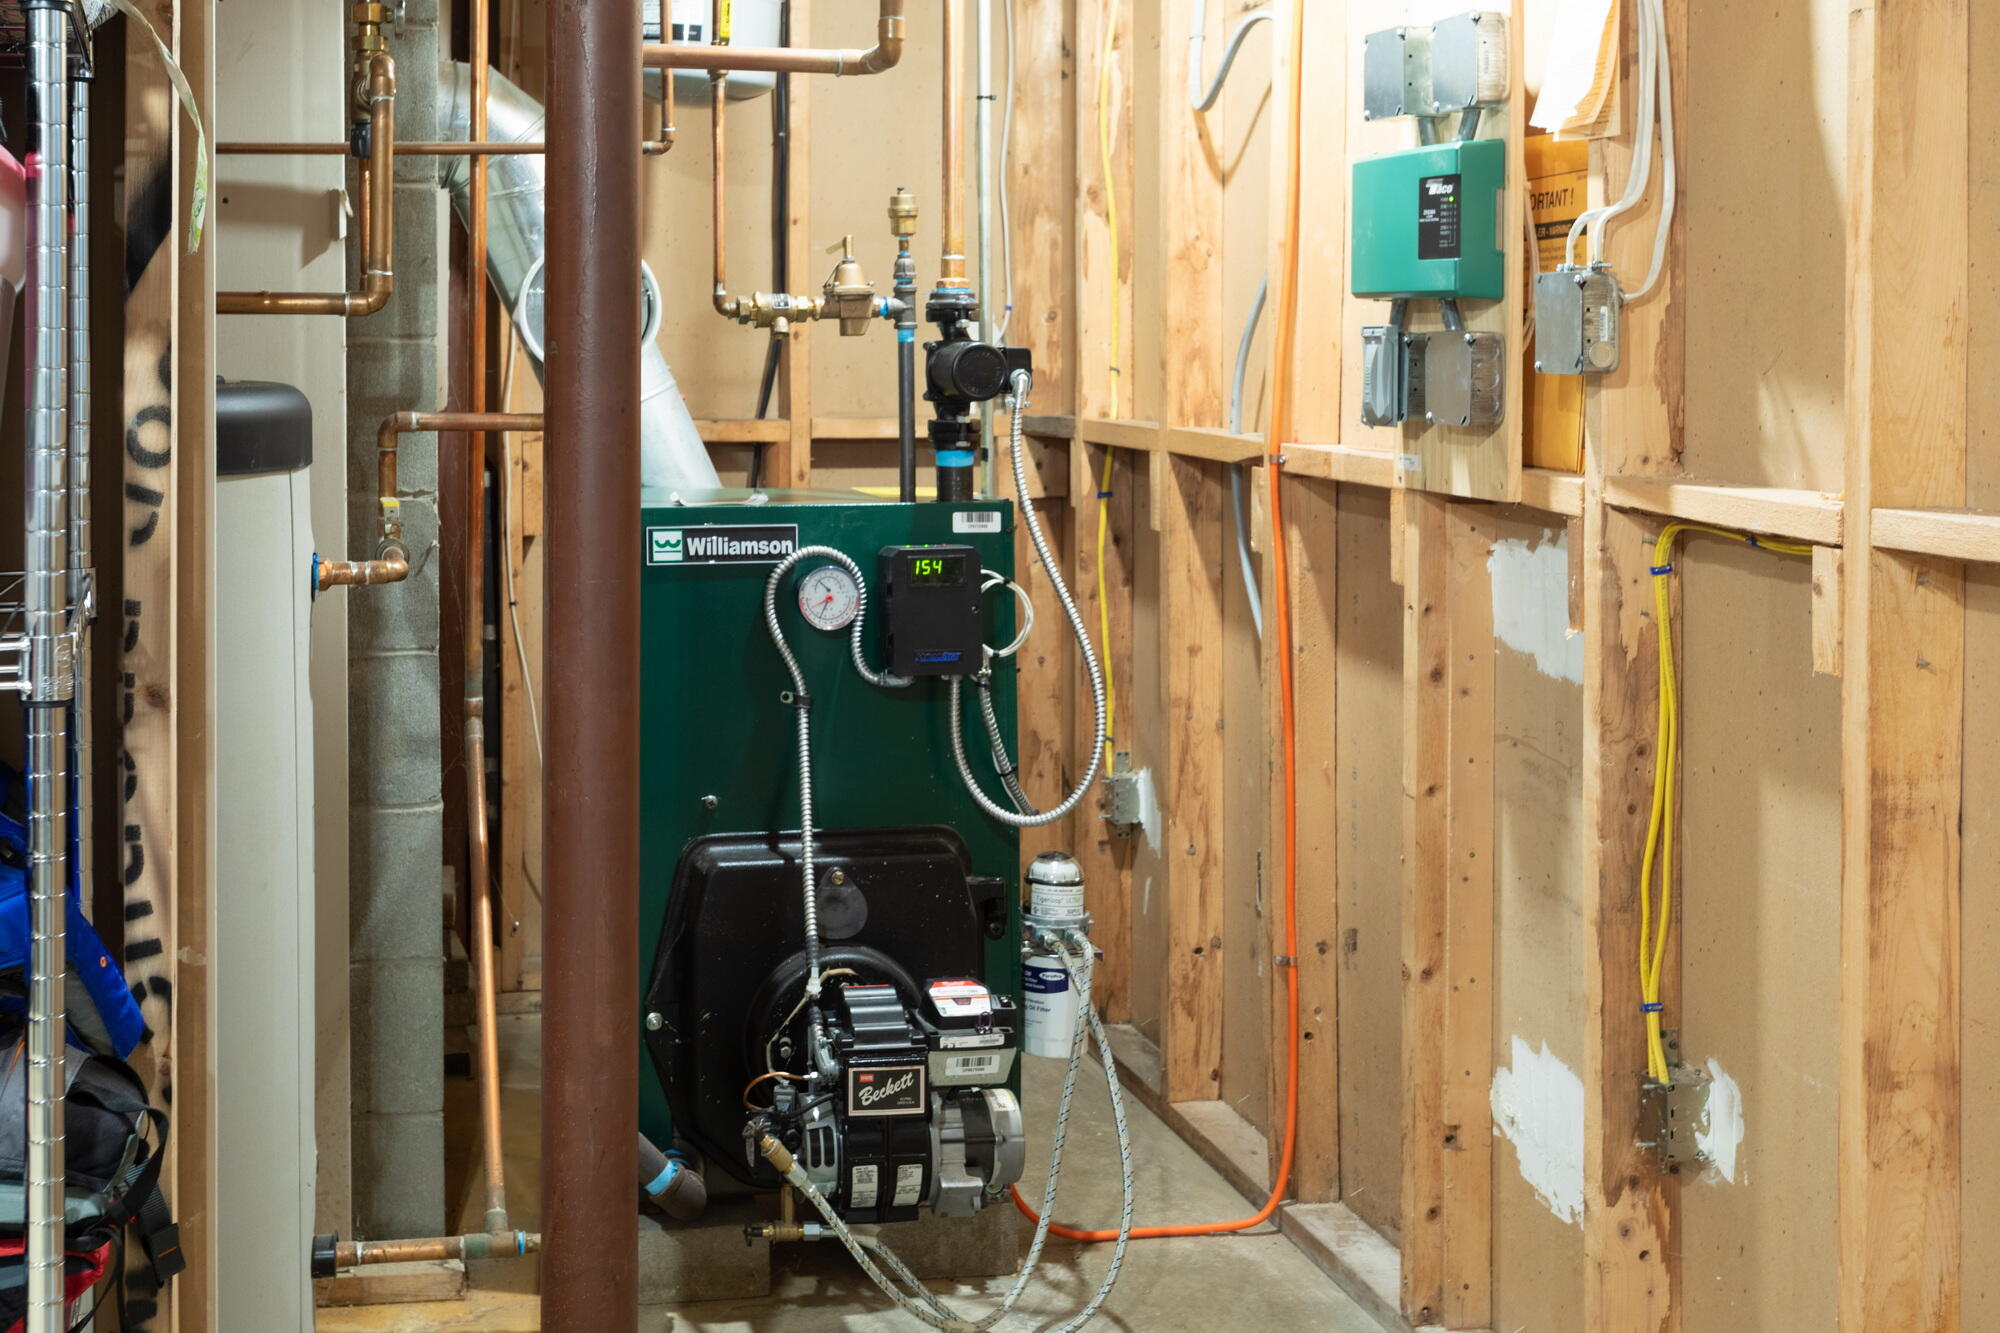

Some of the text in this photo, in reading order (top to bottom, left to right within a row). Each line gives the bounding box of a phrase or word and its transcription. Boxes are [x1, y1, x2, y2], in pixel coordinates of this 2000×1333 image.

[686, 536, 793, 556] Williamson
[915, 560, 943, 576] 154
[858, 1072, 914, 1106] Beckett
